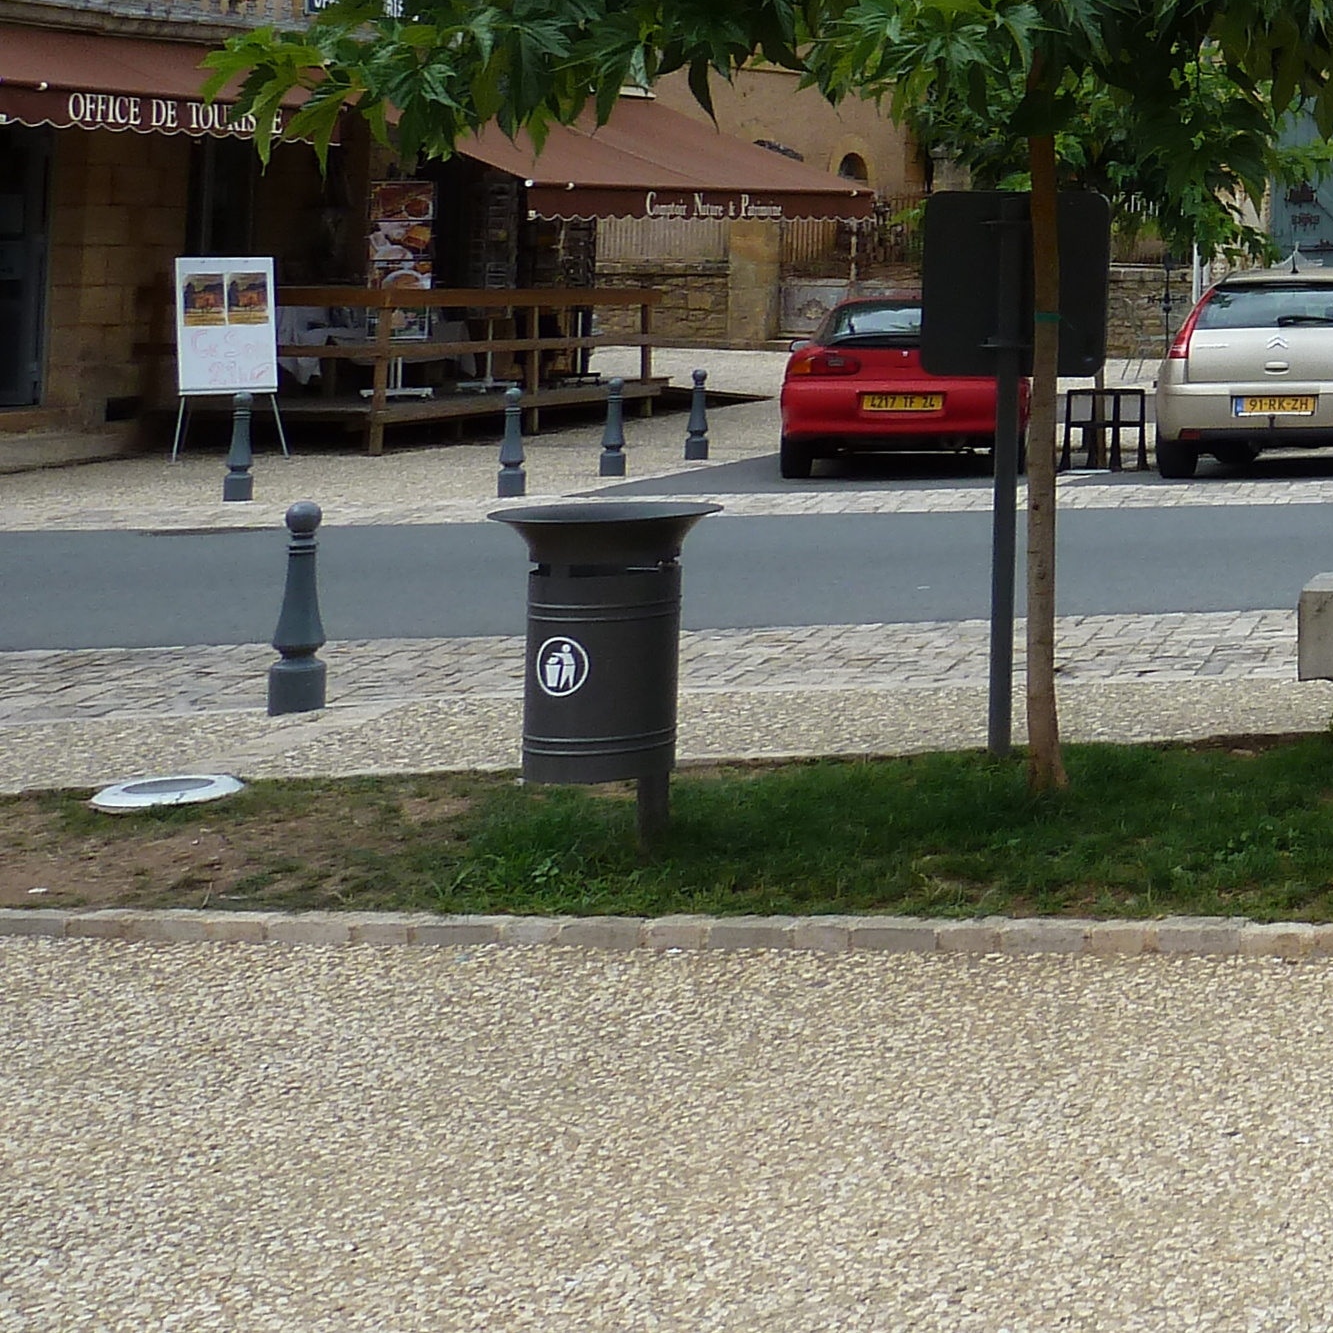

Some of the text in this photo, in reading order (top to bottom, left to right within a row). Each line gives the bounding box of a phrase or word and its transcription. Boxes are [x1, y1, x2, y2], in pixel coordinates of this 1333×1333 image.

[68, 92, 283, 134] OFFICE DE TOUISE
[646, 191, 687, 218] Comptoir
[693, 192, 724, 217] Nature
[741, 194, 782, 217] Patrimoine
[1249, 398, 1309, 411] 91-RK-ZH
